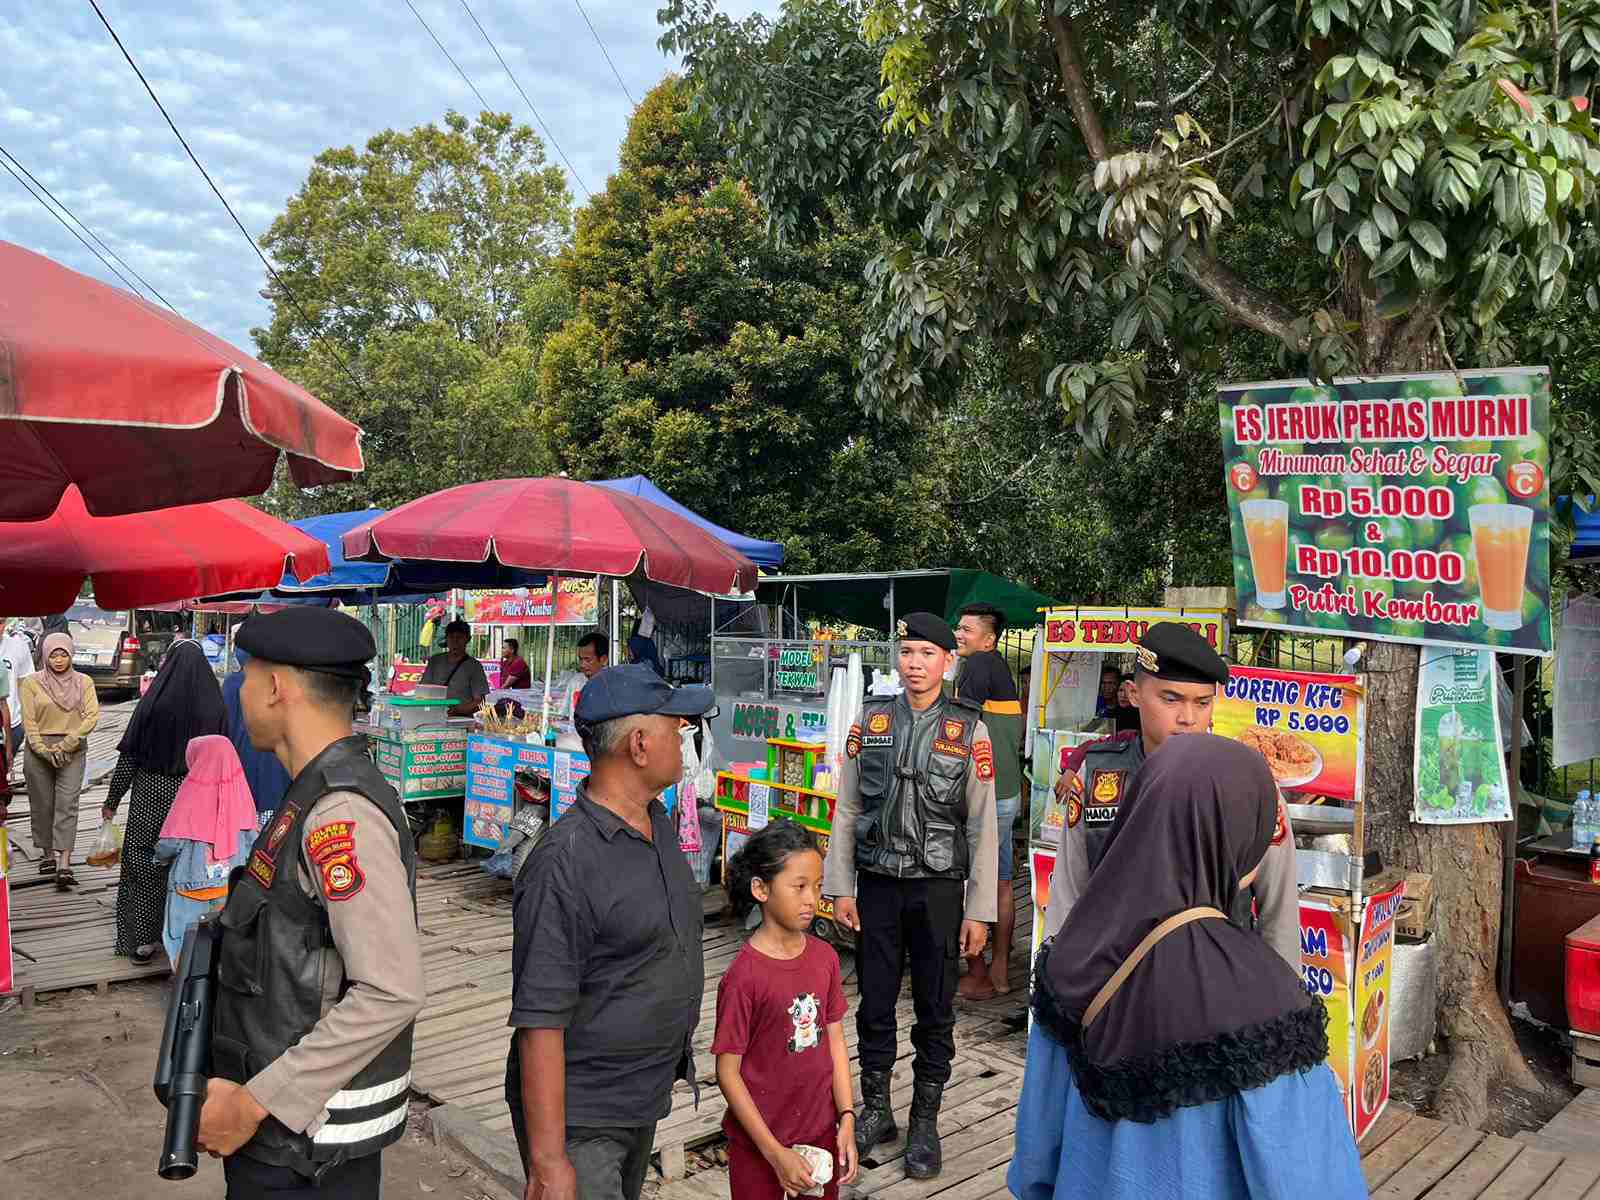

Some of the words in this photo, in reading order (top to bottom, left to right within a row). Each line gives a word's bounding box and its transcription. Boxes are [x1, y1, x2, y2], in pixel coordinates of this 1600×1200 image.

[1234, 405, 1261, 442] ES
[1267, 402, 1338, 440] JERUK
[1343, 400, 1424, 438] PERAS
[1431, 397, 1530, 437] MURNI
[1258, 449, 1346, 476] Minuman
[1350, 448, 1408, 475] Sehat
[1408, 453, 1427, 474] &
[1431, 448, 1501, 483] Segar
[1301, 487, 1343, 518] Rp
[1350, 487, 1453, 518] 5.000
[1365, 523, 1382, 543] &
[1297, 546, 1338, 577] Rp
[1343, 548, 1462, 583] 10.000
[1290, 585, 1356, 615] Putri
[1363, 590, 1478, 625] Kembar
[1046, 620, 1076, 643] ES
[779, 649, 813, 668] MODEL
[776, 671, 817, 689] TEKWAN
[1223, 676, 1299, 704] GORENG
[1305, 682, 1344, 710] KFC
[784, 713, 797, 740] &
[1255, 706, 1281, 730] RP
[1287, 711, 1350, 734] 5.000
[1084, 807, 1118, 821] HAIQA
